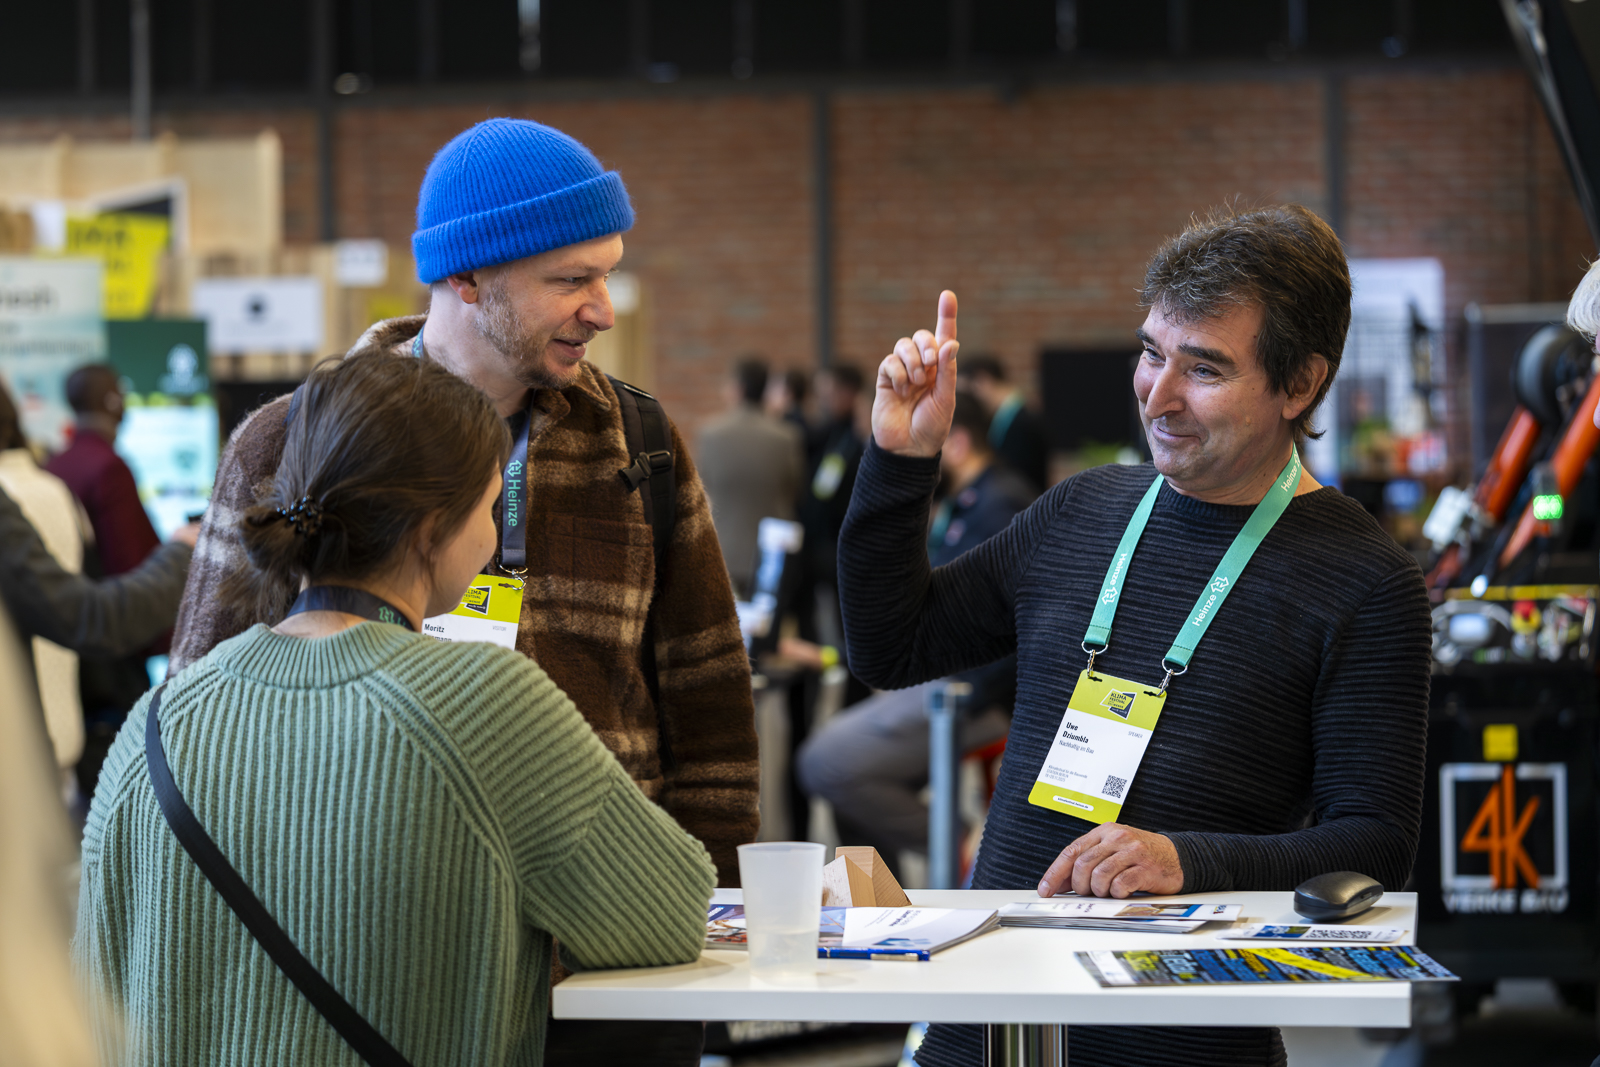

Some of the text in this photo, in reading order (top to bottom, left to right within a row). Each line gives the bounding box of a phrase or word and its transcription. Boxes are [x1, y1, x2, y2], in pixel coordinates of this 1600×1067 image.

[1281, 465, 1297, 492] Heinze
[507, 479, 521, 527] Heinze
[1109, 553, 1127, 586] Heinze
[1192, 594, 1217, 627] Heinze
[424, 624, 445, 633] Moritz
[1110, 692, 1127, 701] KLIMA
[1065, 721, 1079, 731] Uwe
